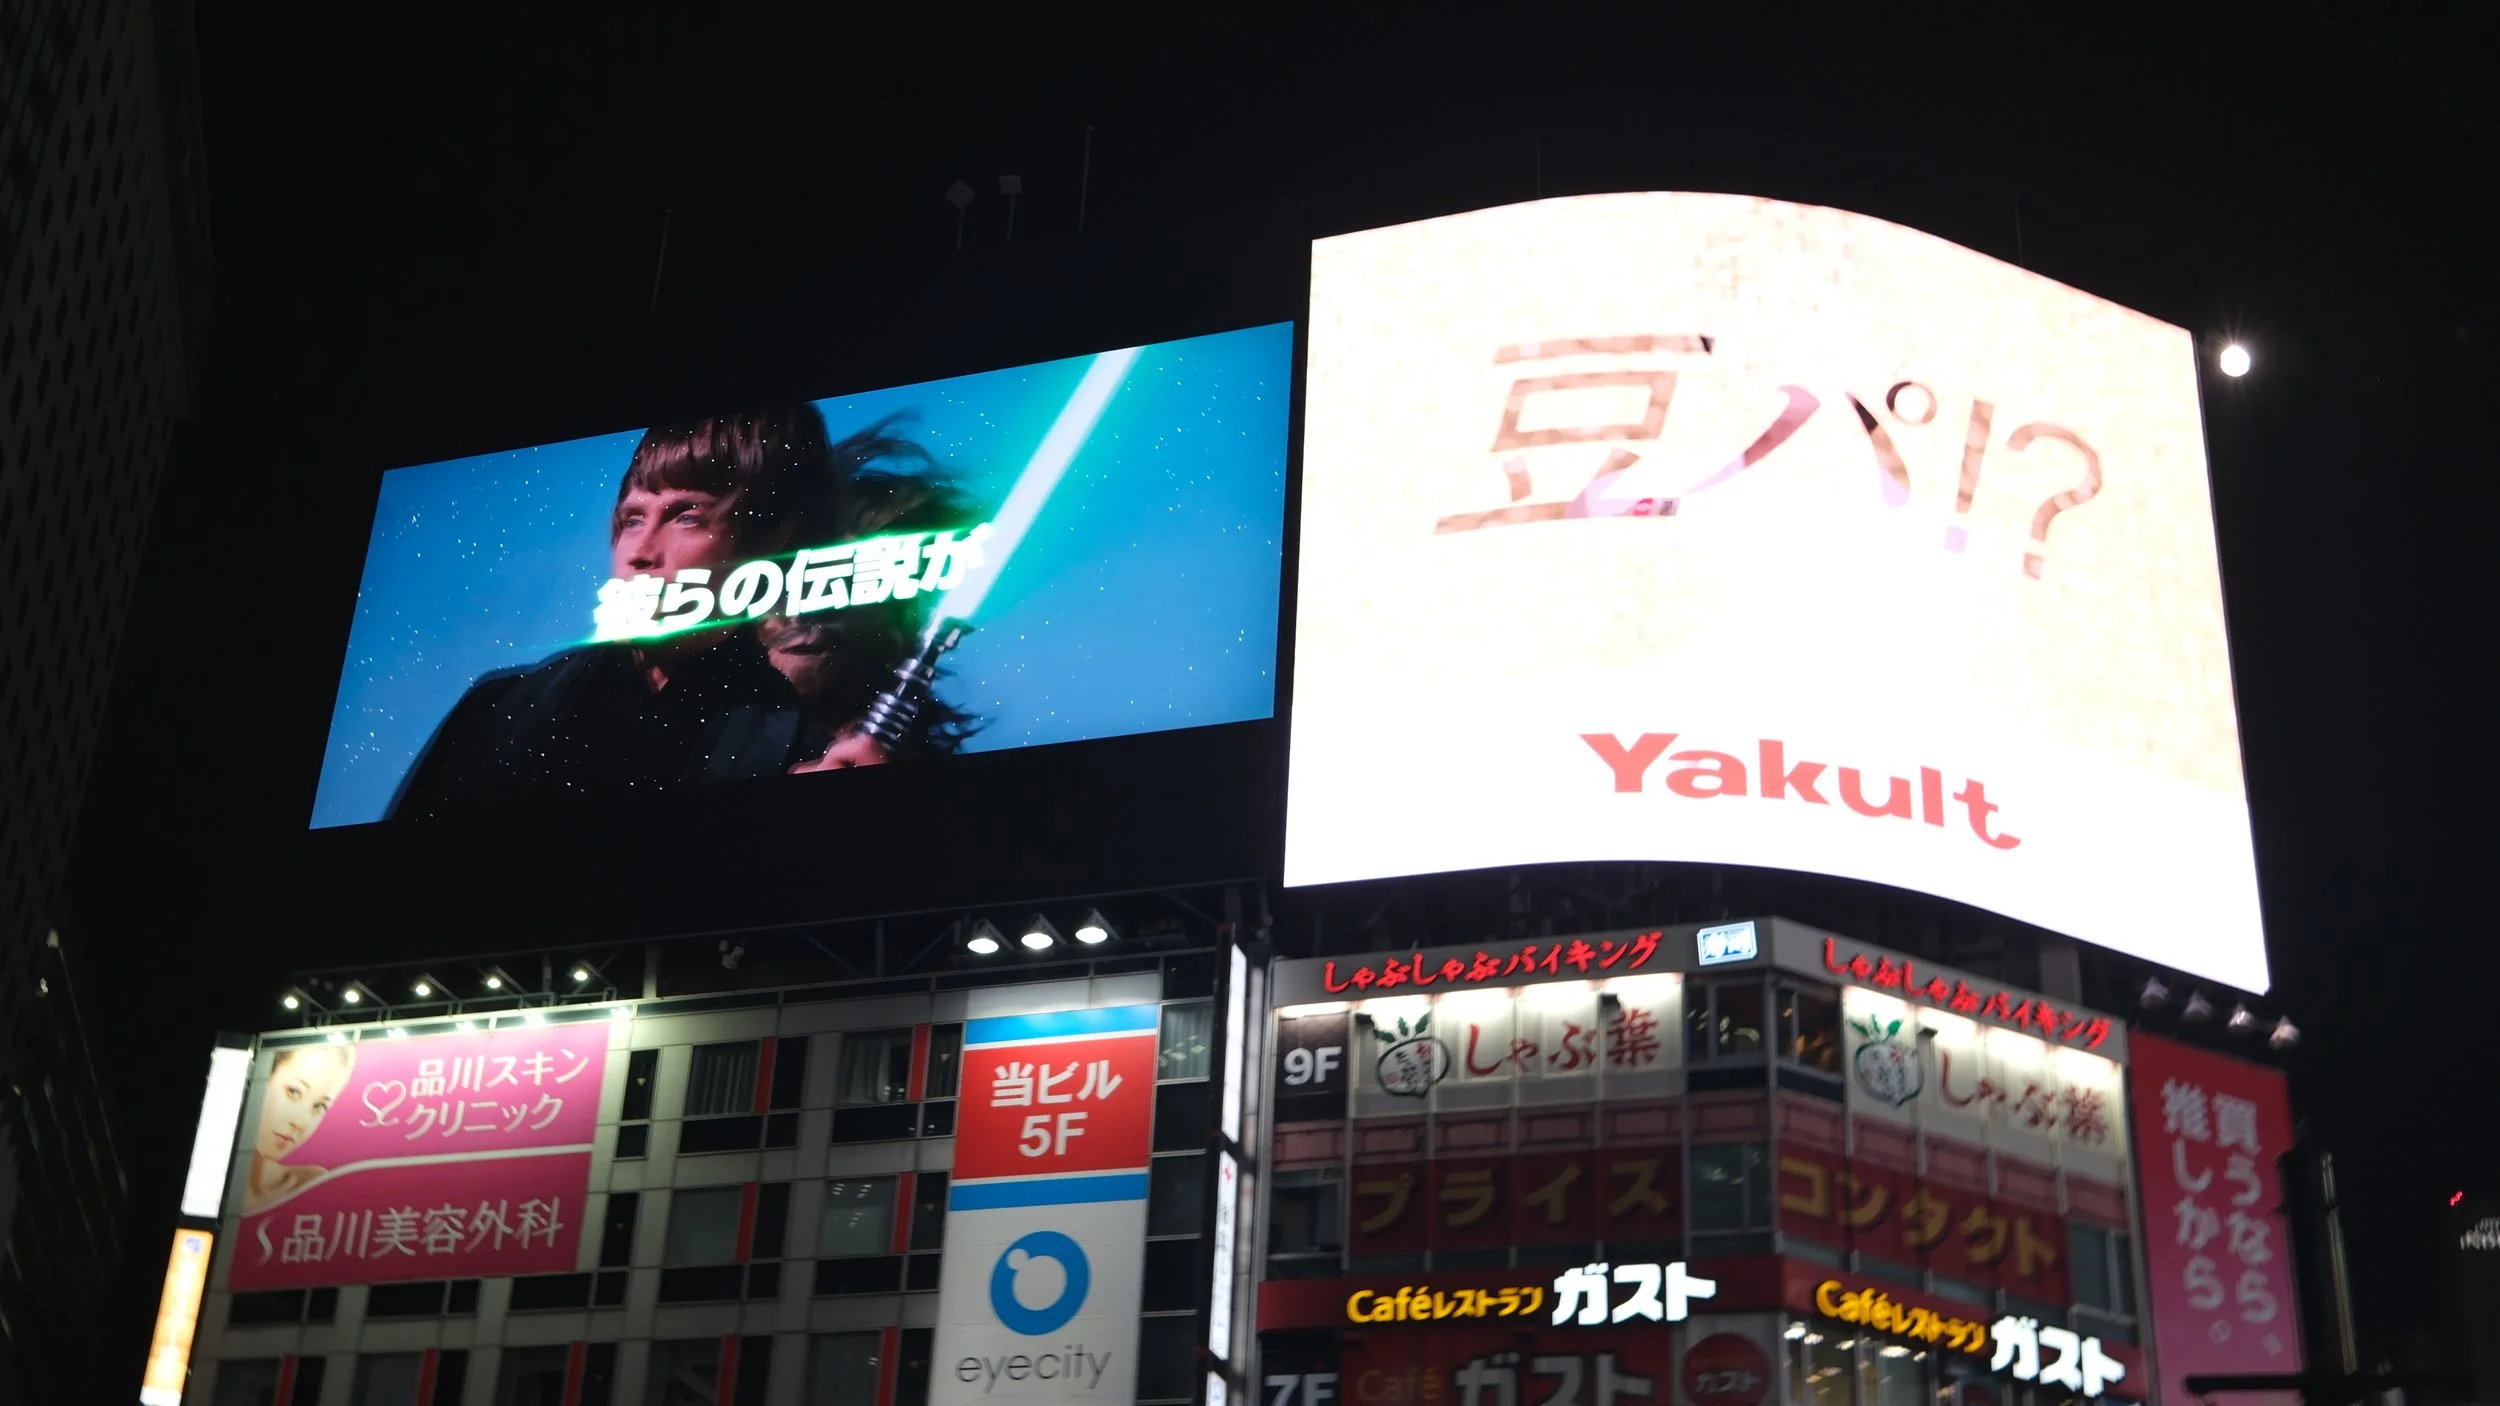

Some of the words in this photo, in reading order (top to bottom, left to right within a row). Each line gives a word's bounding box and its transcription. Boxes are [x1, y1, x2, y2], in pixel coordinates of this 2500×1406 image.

[1579, 733, 2021, 850] Yakult
[1323, 931, 1664, 994] しゃぶしゃぶバイキング
[1824, 936, 2112, 1050] しゃぶしゃぶバイキング
[410, 1048, 590, 1099] 品川スキン
[1283, 1045, 1343, 1087] 9F
[1465, 1007, 1663, 1077] しゃぶ葉
[990, 1059, 1123, 1107] 当ビル
[404, 1092, 564, 1140] クリニック
[1018, 1112, 1088, 1158] 5F
[1356, 1155, 1669, 1233] プライス
[1780, 1156, 2057, 1277] コンタクト
[281, 1196, 563, 1264] 品川美容外科
[1551, 1261, 1717, 1325] ガスト
[954, 1345, 1112, 1393] eyecity
[1455, 1352, 1652, 1406] ガスト
[1990, 1314, 2125, 1397] ガスト
[1265, 1372, 1339, 1406] 7F
